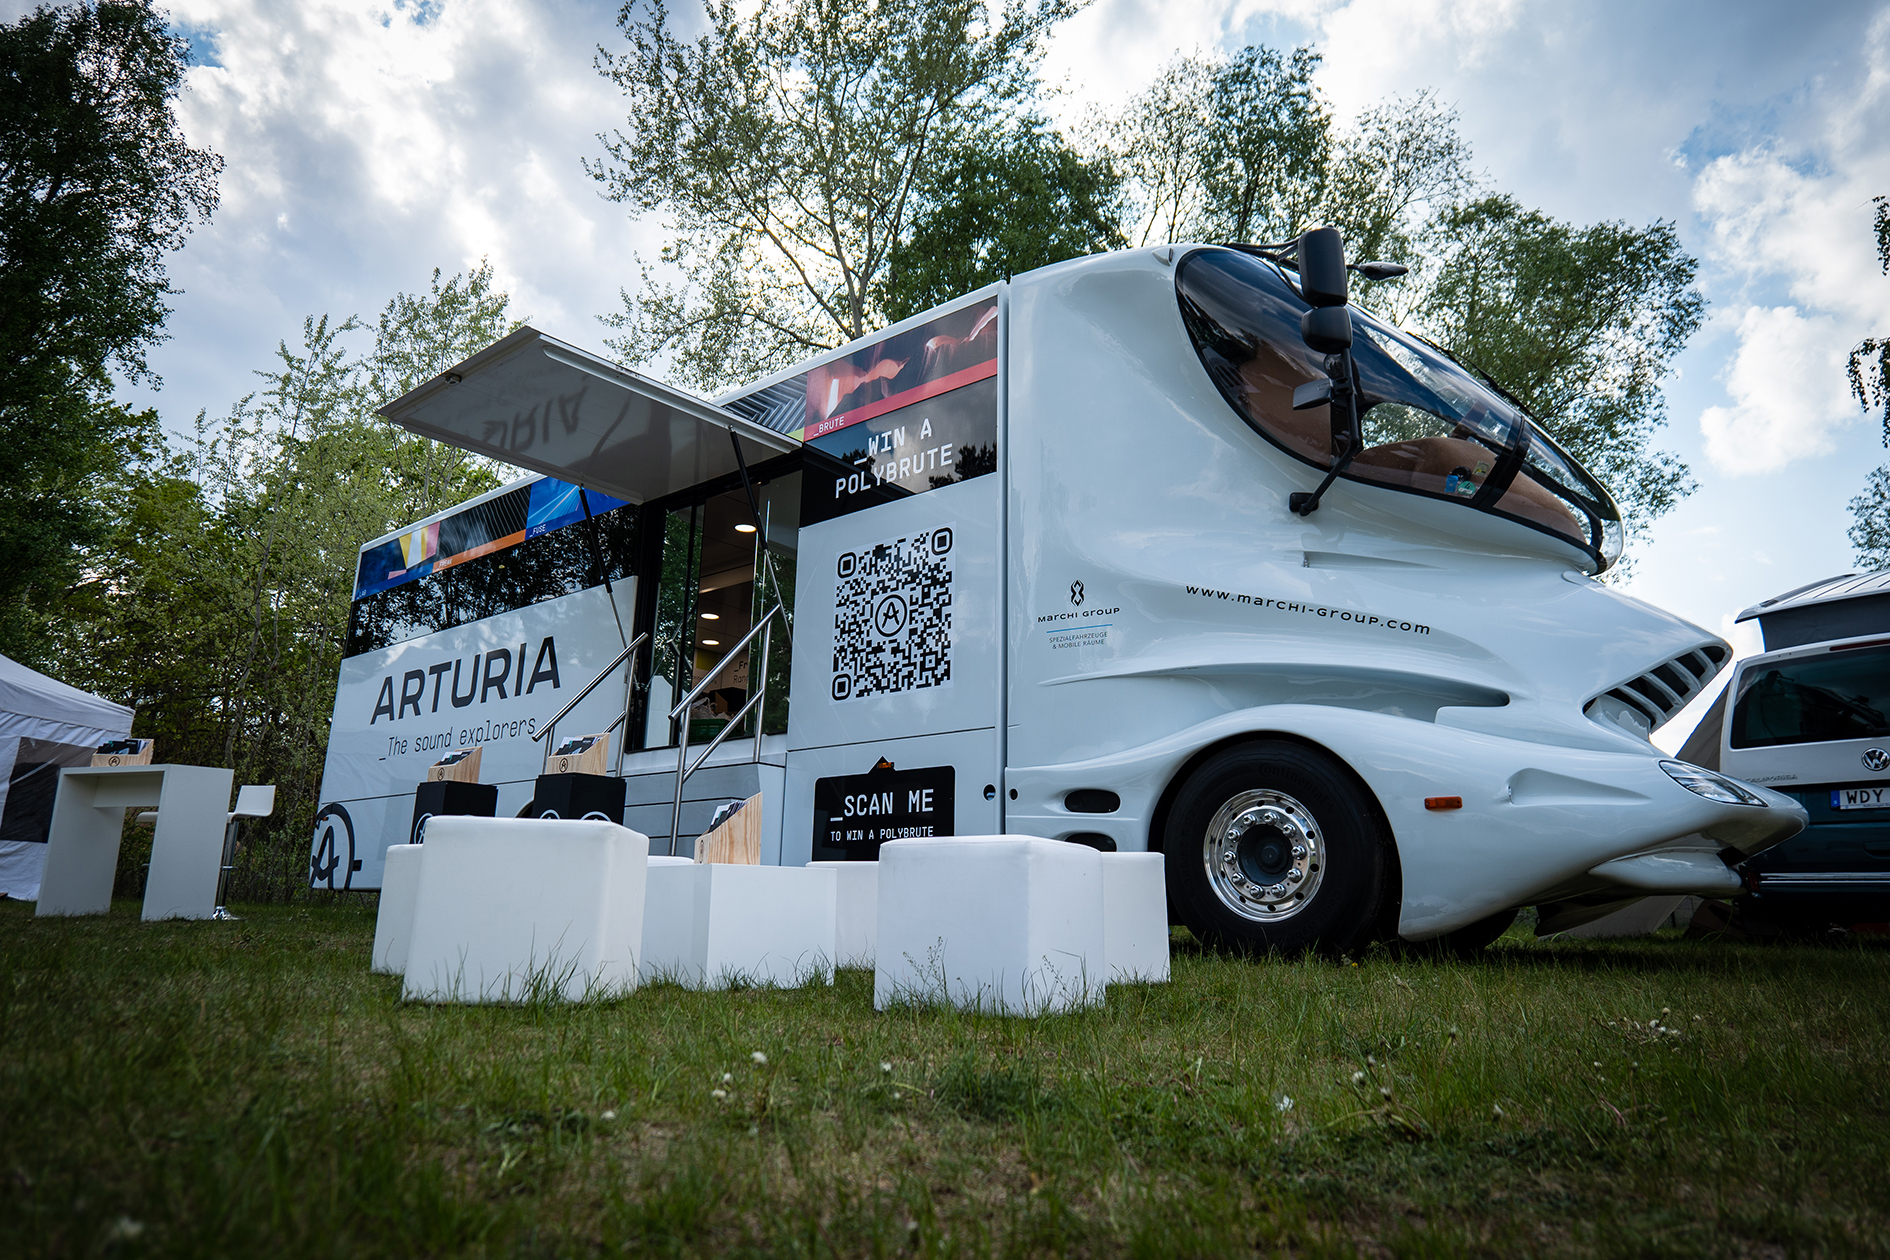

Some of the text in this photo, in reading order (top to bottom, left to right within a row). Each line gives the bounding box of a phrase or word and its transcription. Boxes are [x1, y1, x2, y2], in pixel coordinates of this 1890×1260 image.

[813, 416, 845, 437] _BRUTE
[920, 418, 932, 441] A
[835, 443, 953, 498] POLYBRUTE
[1049, 631, 1108, 643] SPEZIALFAHRZEUGE
[1058, 641, 1081, 649] MOBILE
[370, 635, 560, 725] ARTURIA
[414, 726, 452, 754] sound
[459, 716, 536, 748] explorers
[907, 788, 934, 814] ME
[1846, 788, 1884, 804] WDY
[830, 826, 934, 842] TO WIN A POLYBRUTE
